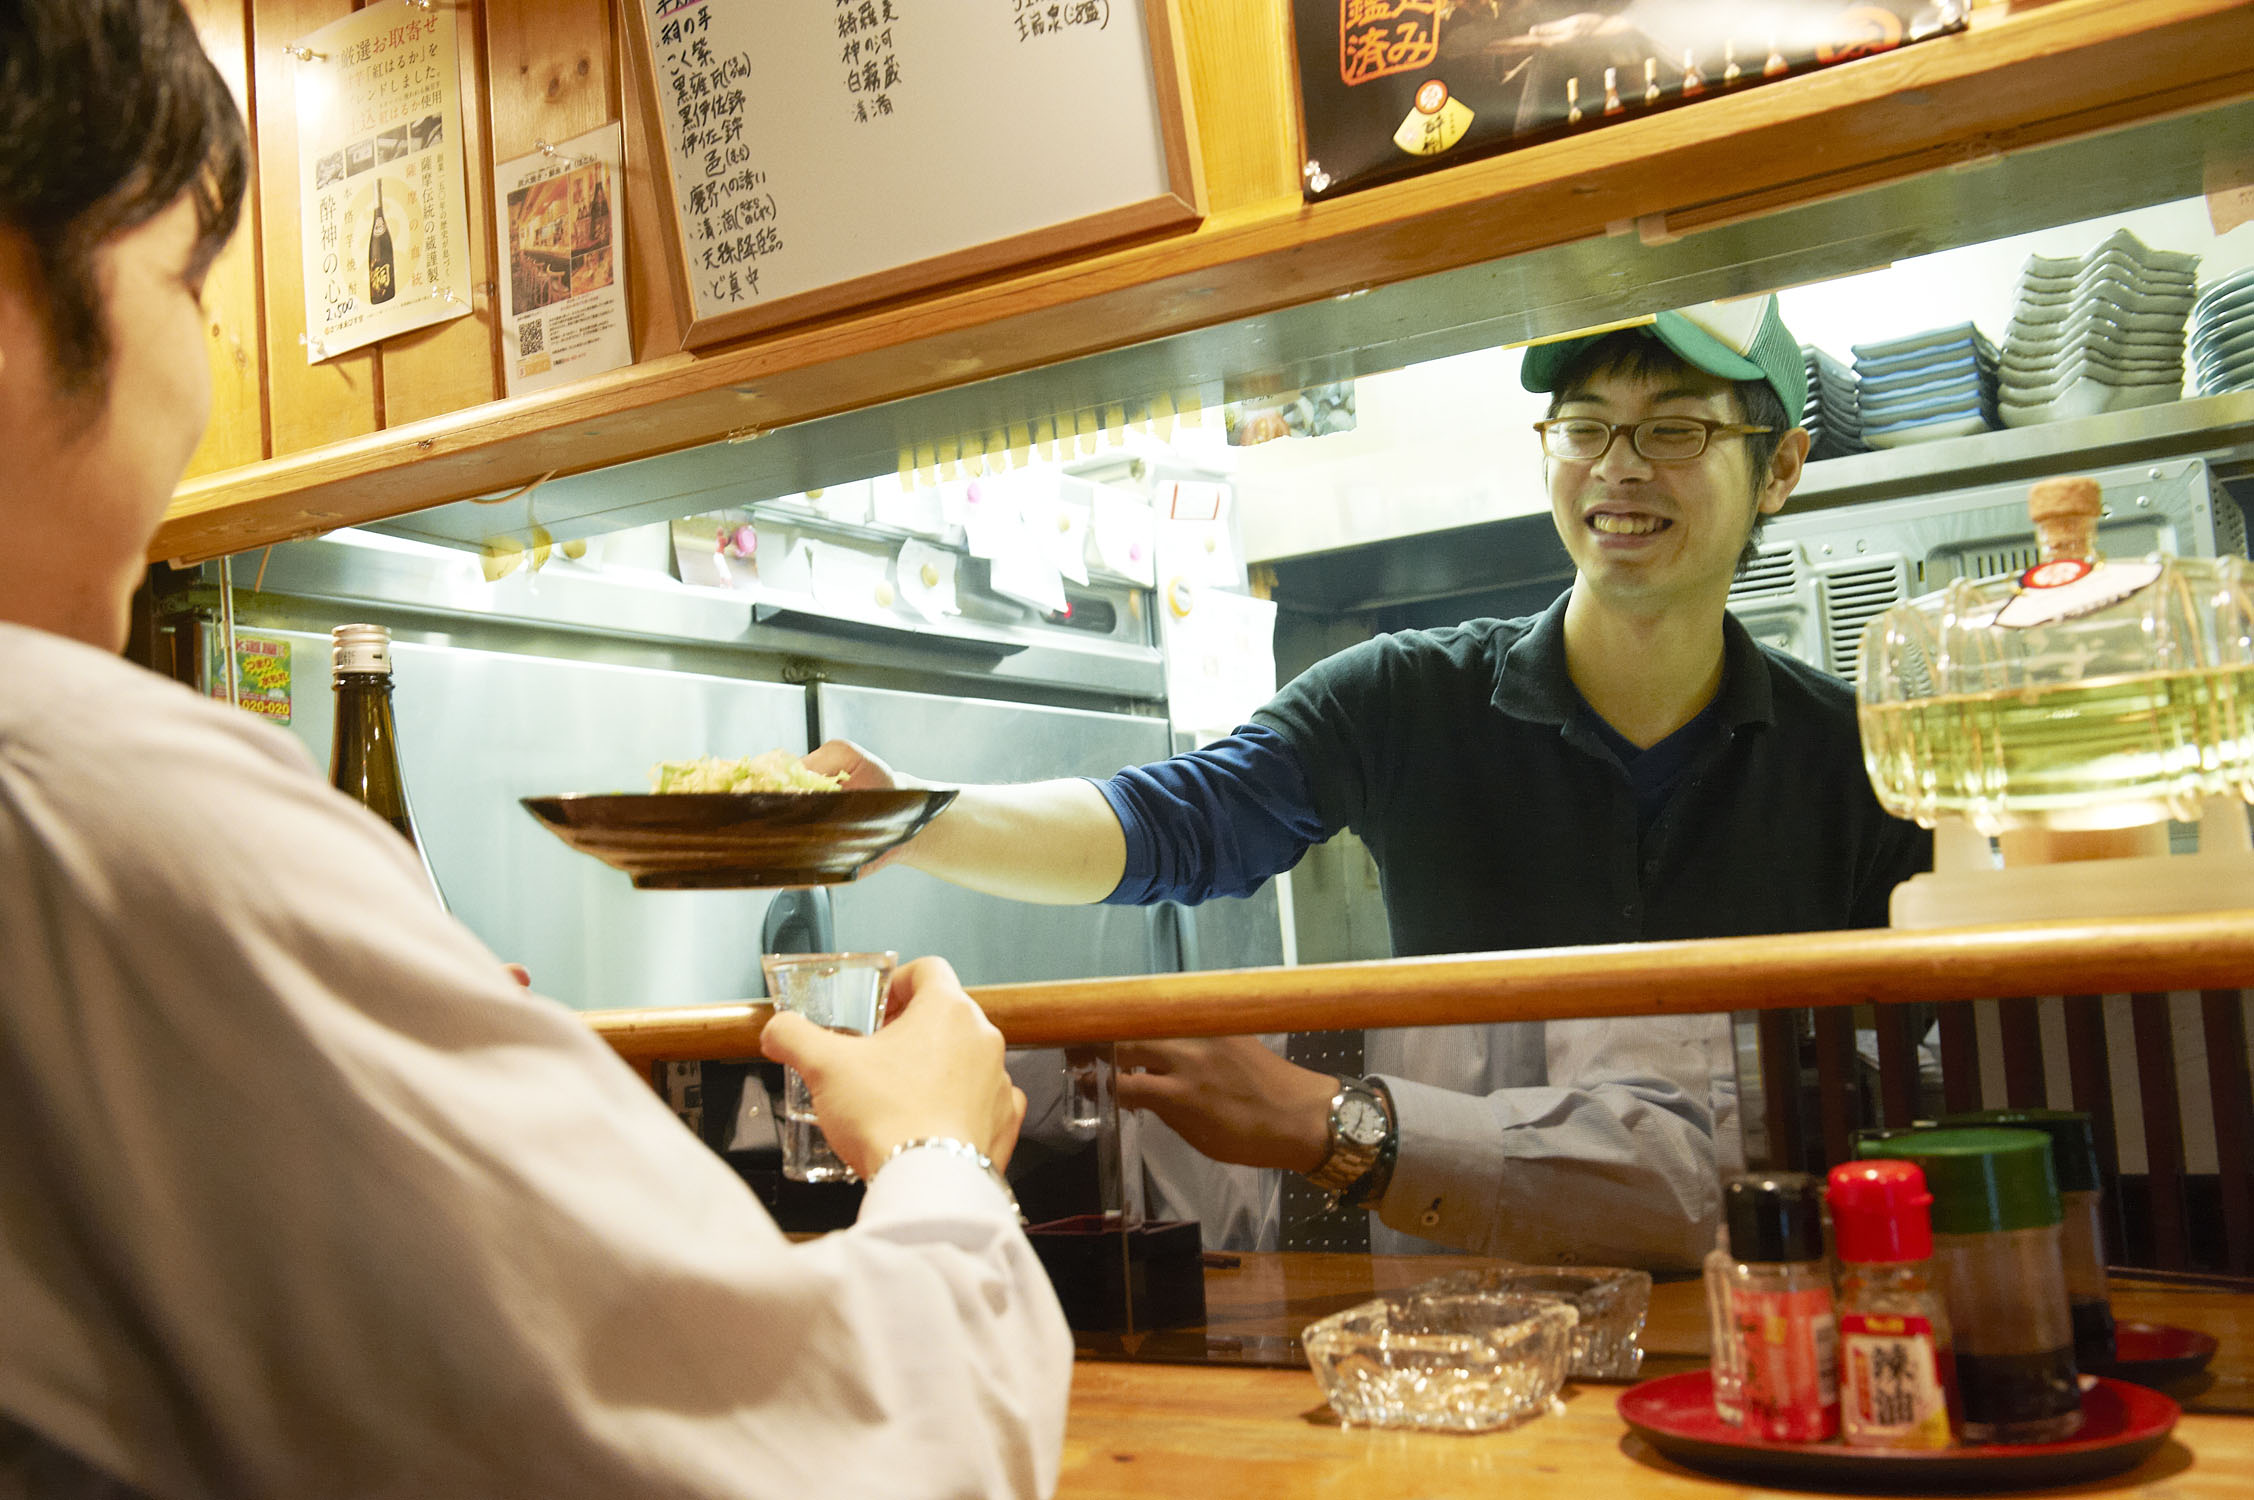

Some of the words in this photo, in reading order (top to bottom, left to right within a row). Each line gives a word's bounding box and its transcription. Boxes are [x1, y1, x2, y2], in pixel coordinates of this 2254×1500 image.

[842, 27, 893, 65] 神の河
[1346, 22, 1434, 80] 済み
[678, 88, 746, 134] 黒伊佐錦
[681, 116, 743, 158] 伊佐錦
[689, 168, 766, 215] 魔界への誘い
[319, 194, 341, 304] 酔神の心
[709, 265, 760, 303] ど真中
